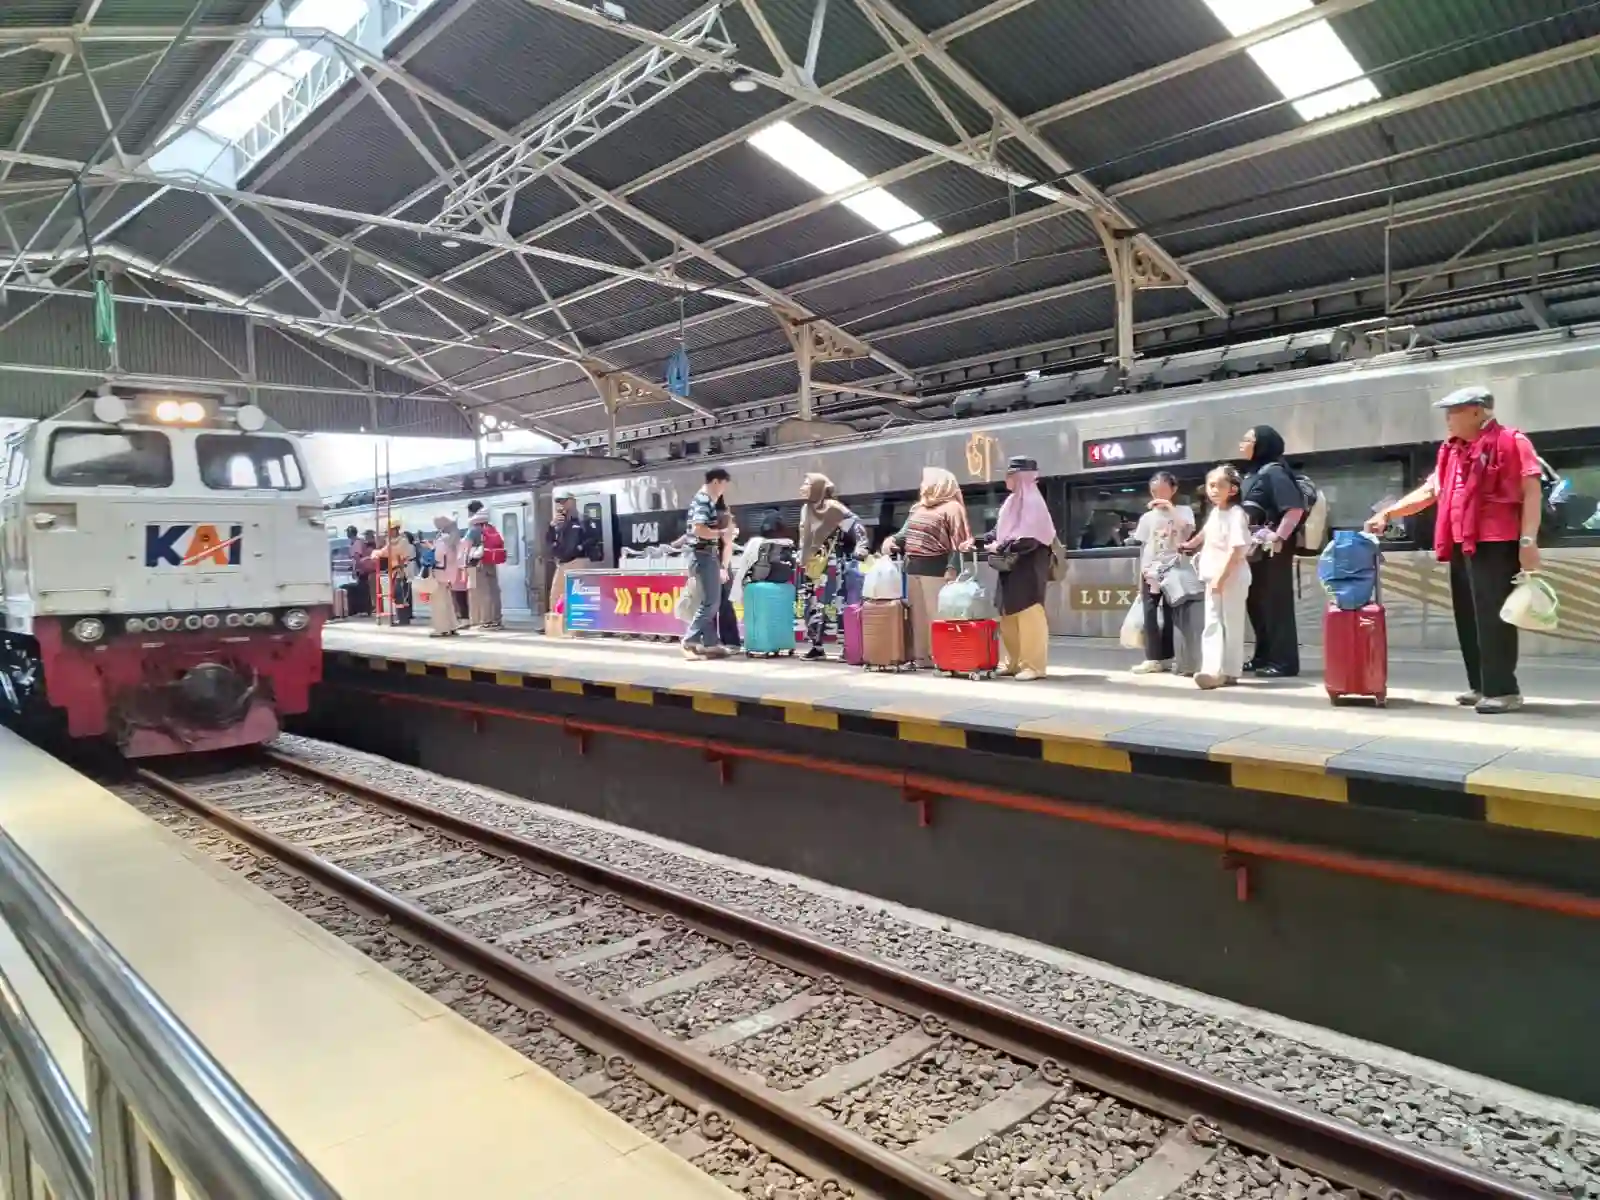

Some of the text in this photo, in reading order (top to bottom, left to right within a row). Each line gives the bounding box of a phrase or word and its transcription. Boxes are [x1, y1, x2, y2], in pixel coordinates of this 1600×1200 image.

[632, 522, 659, 543] KAI
[145, 522, 243, 567] KAI
[1080, 589, 1140, 605] LUX
